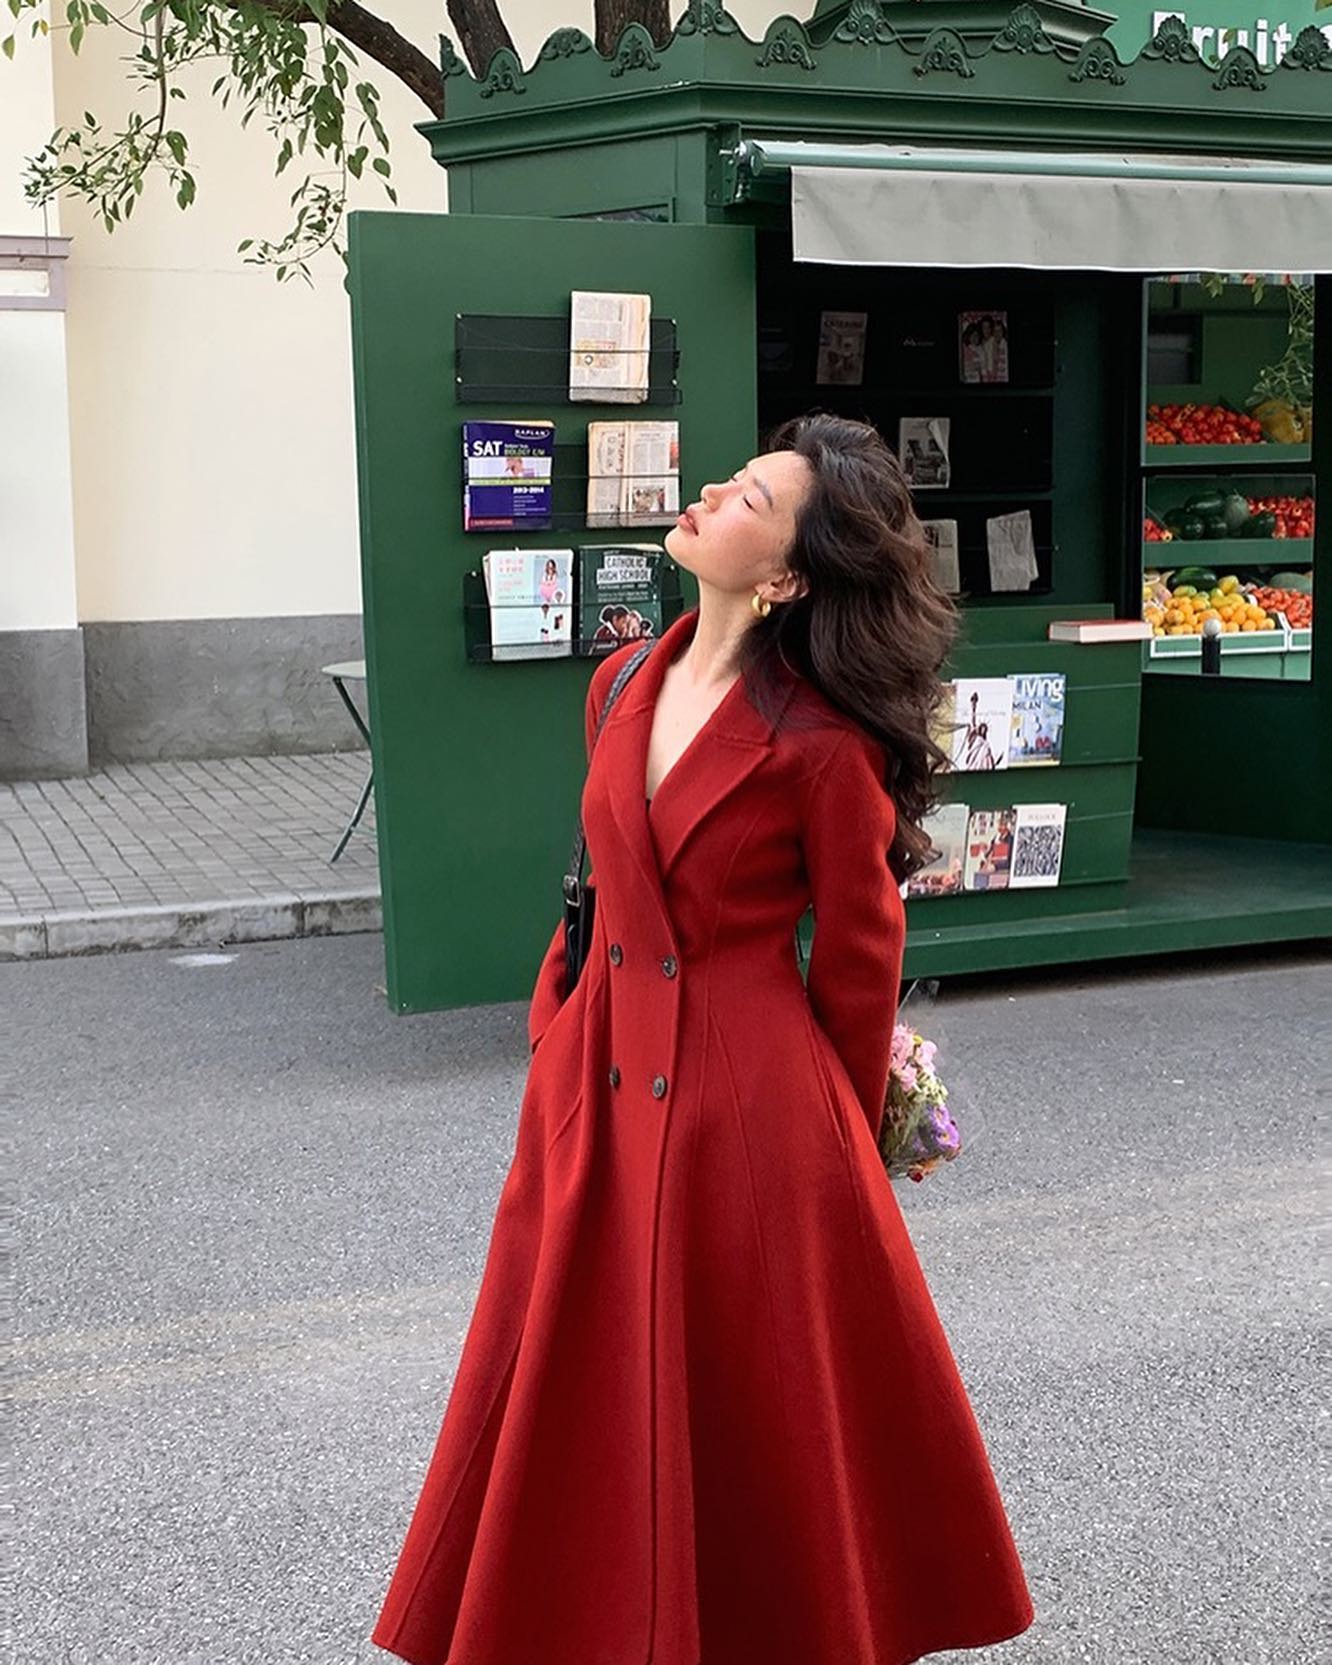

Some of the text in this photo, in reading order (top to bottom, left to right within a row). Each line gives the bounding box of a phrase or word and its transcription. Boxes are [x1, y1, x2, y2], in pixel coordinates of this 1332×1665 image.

[473, 440, 503, 456] SAT
[606, 557, 645, 569] CATHOLIC
[599, 568, 649, 582] HIGH SCHOOL
